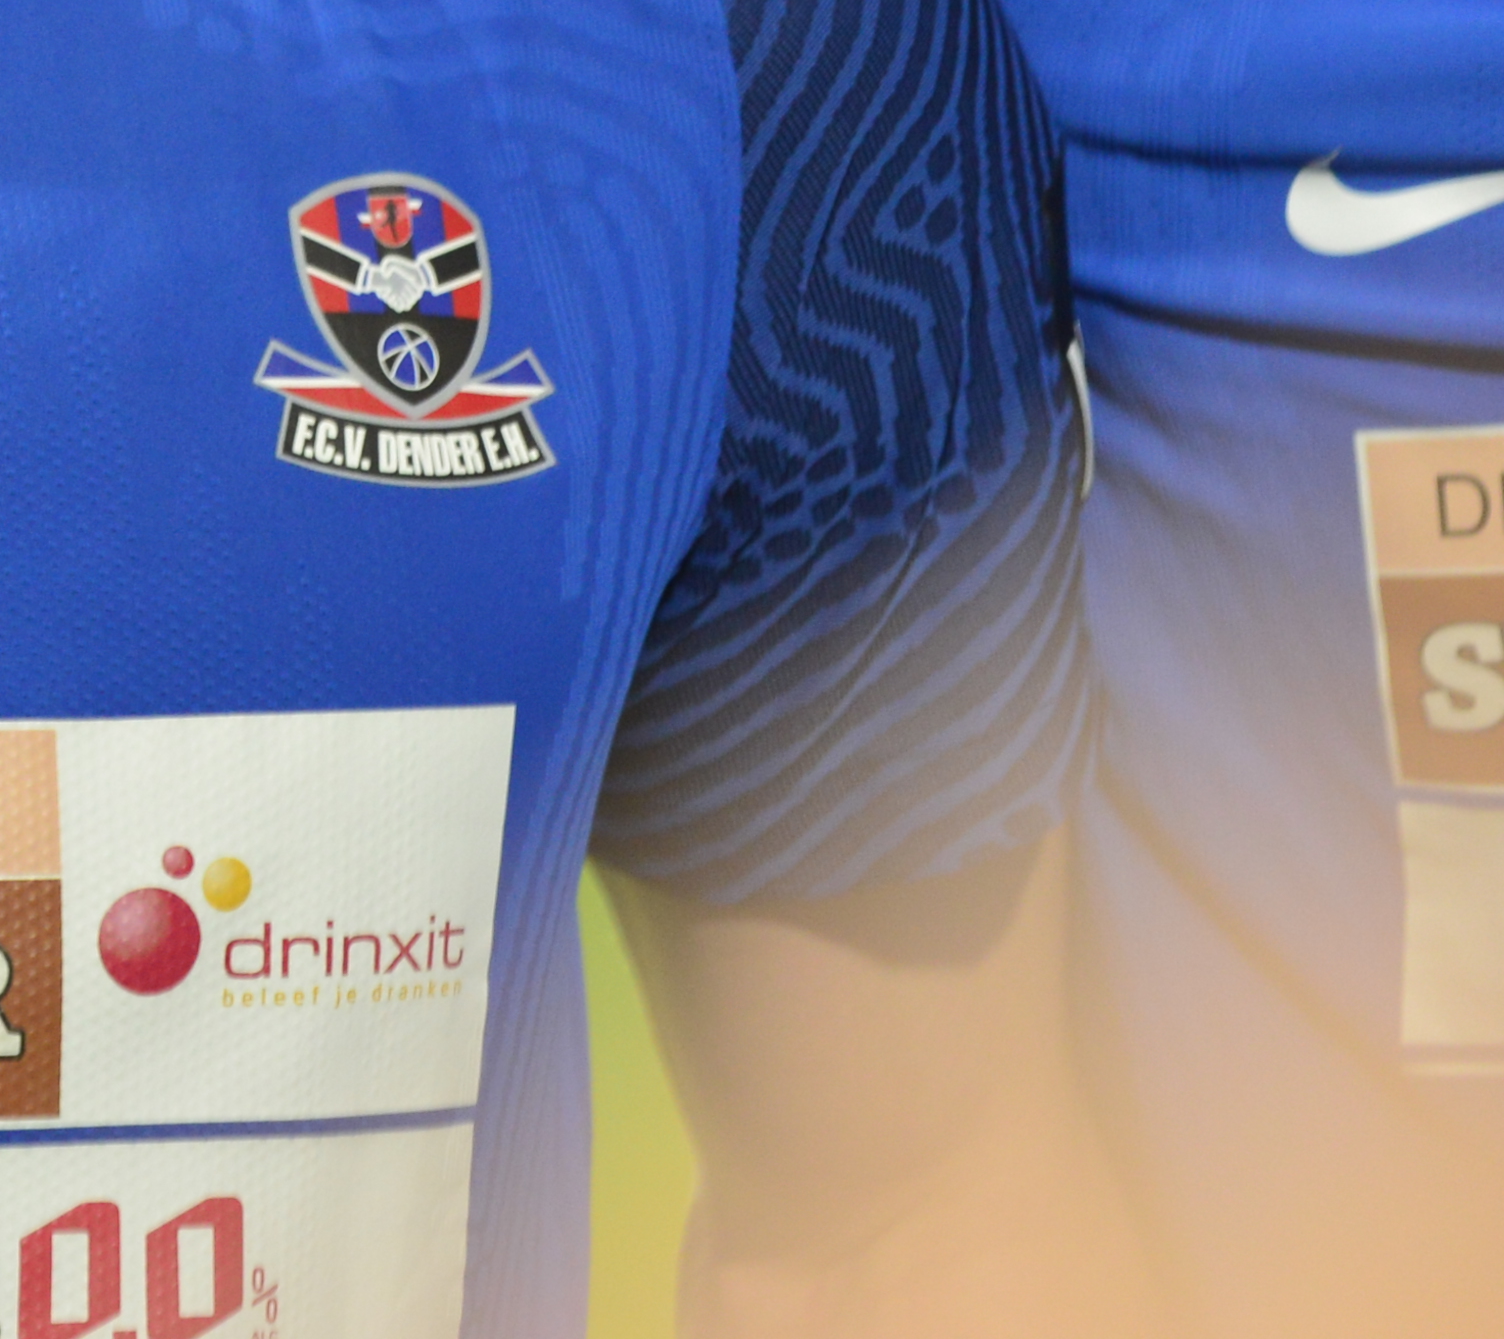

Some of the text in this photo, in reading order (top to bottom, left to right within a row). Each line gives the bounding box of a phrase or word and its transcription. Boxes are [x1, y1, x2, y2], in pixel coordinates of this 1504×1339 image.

[292, 414, 540, 477] F.C.V. DENDER E.H.
[224, 915, 465, 979] drinxit
[222, 979, 462, 1009] beleef je dranken
